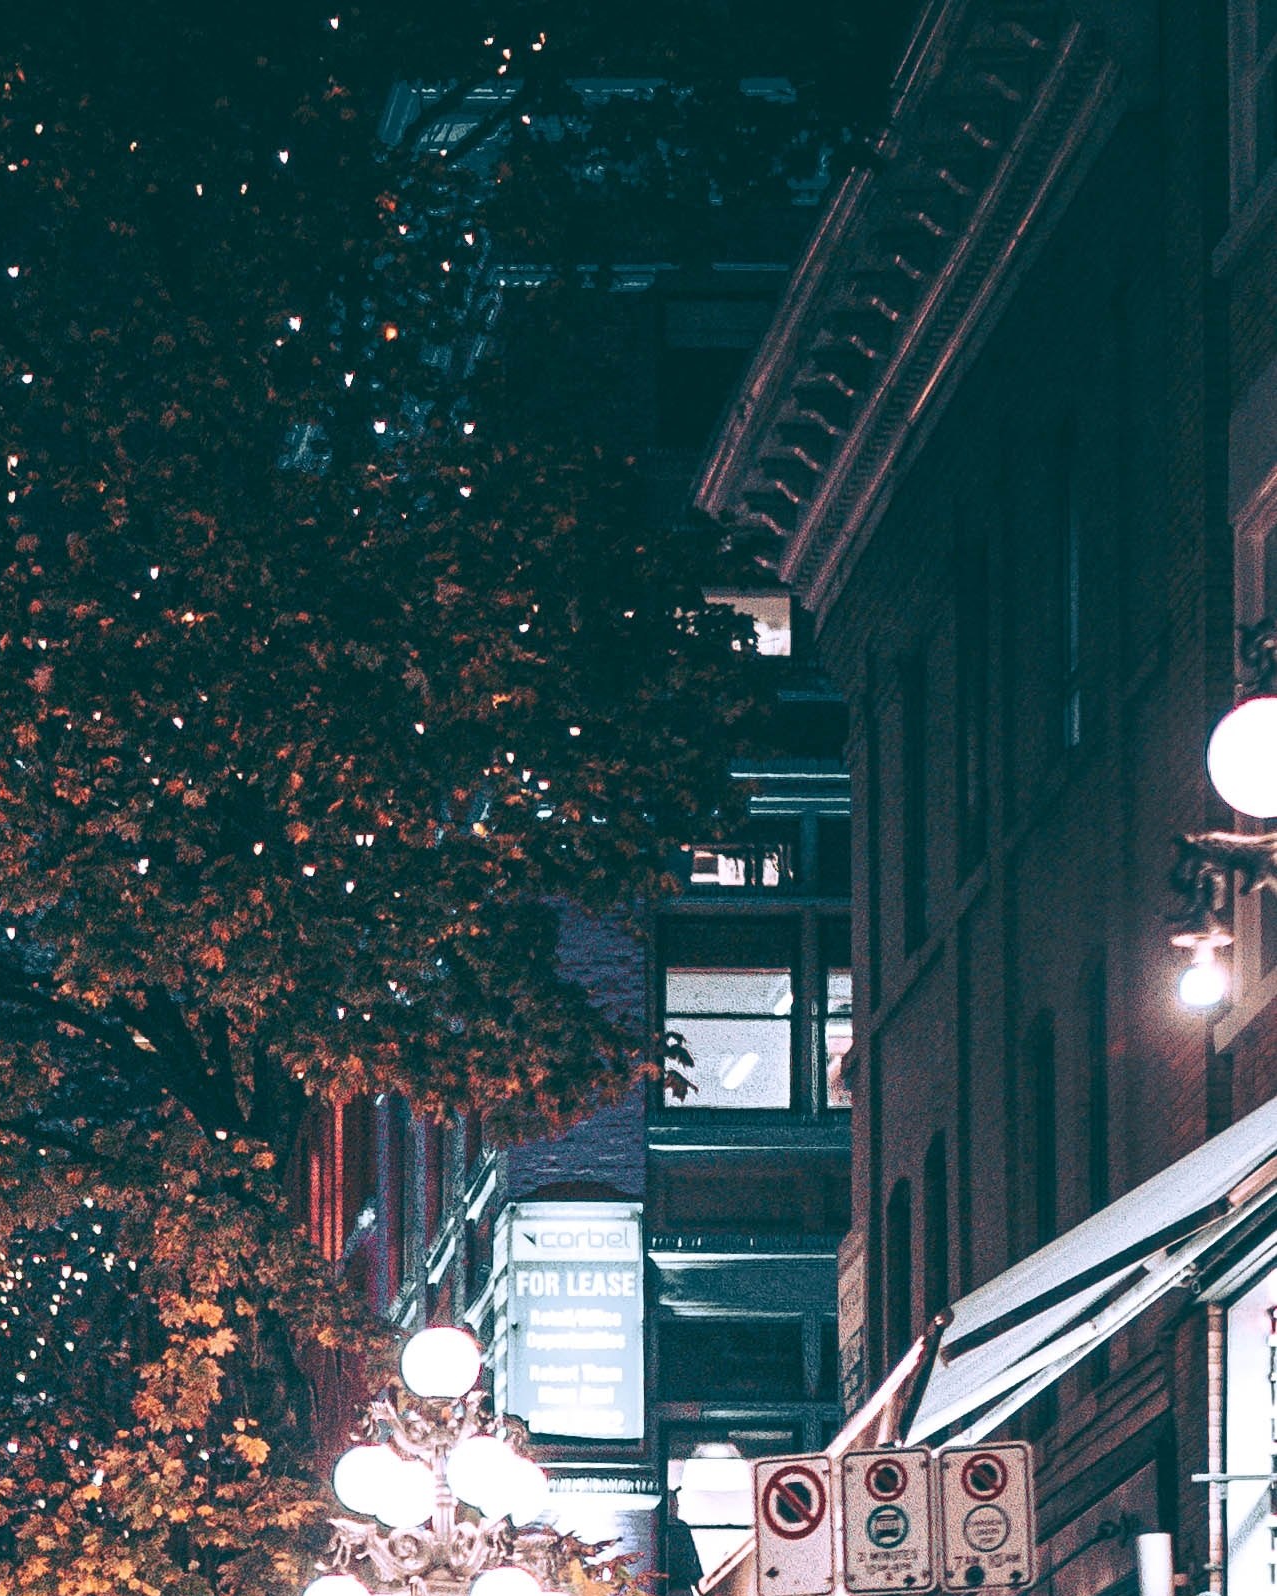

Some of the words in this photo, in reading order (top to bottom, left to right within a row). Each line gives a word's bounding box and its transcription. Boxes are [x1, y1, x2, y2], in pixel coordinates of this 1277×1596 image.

[540, 1227, 631, 1249] corbel
[516, 1271, 560, 1297] FOR
[567, 1271, 636, 1297] LEASE
